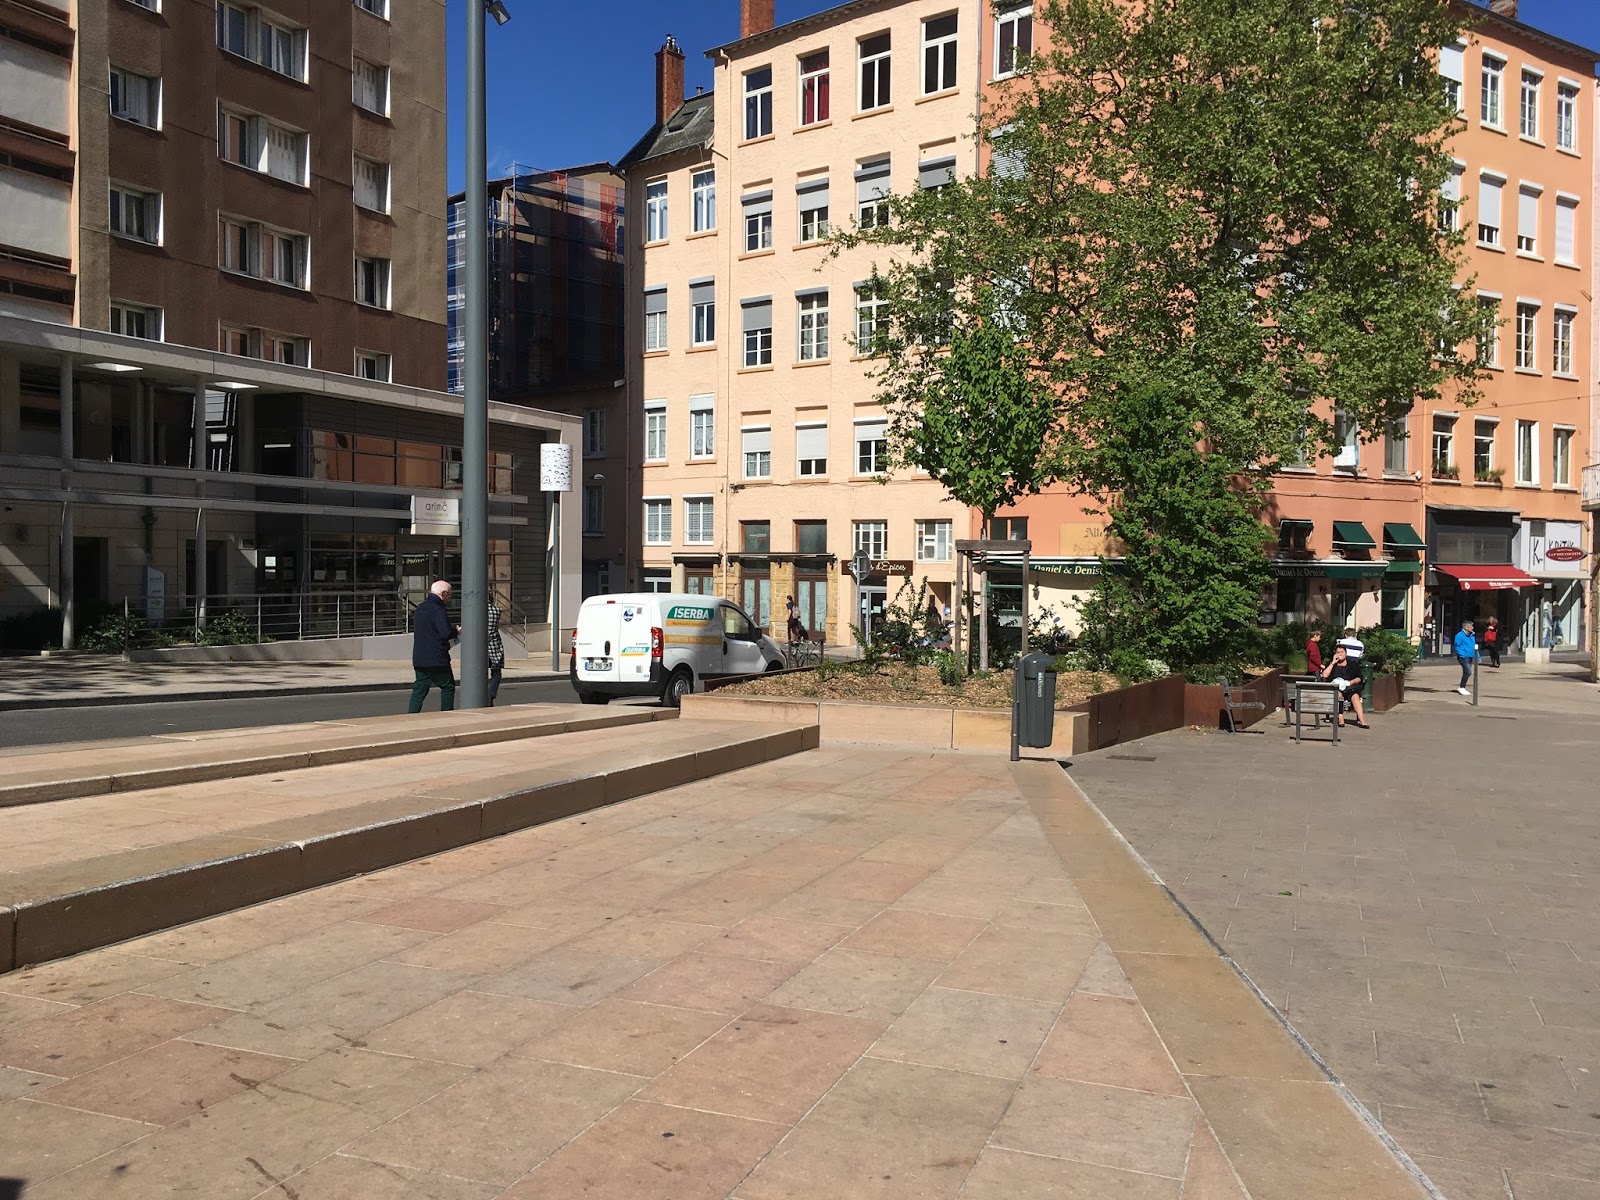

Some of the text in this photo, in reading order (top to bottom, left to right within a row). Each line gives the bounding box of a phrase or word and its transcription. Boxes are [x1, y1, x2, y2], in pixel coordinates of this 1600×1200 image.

[1063, 565, 1072, 574] &
[1274, 567, 1326, 577] Daniel & Denise
[673, 607, 710, 620] ISERBA
